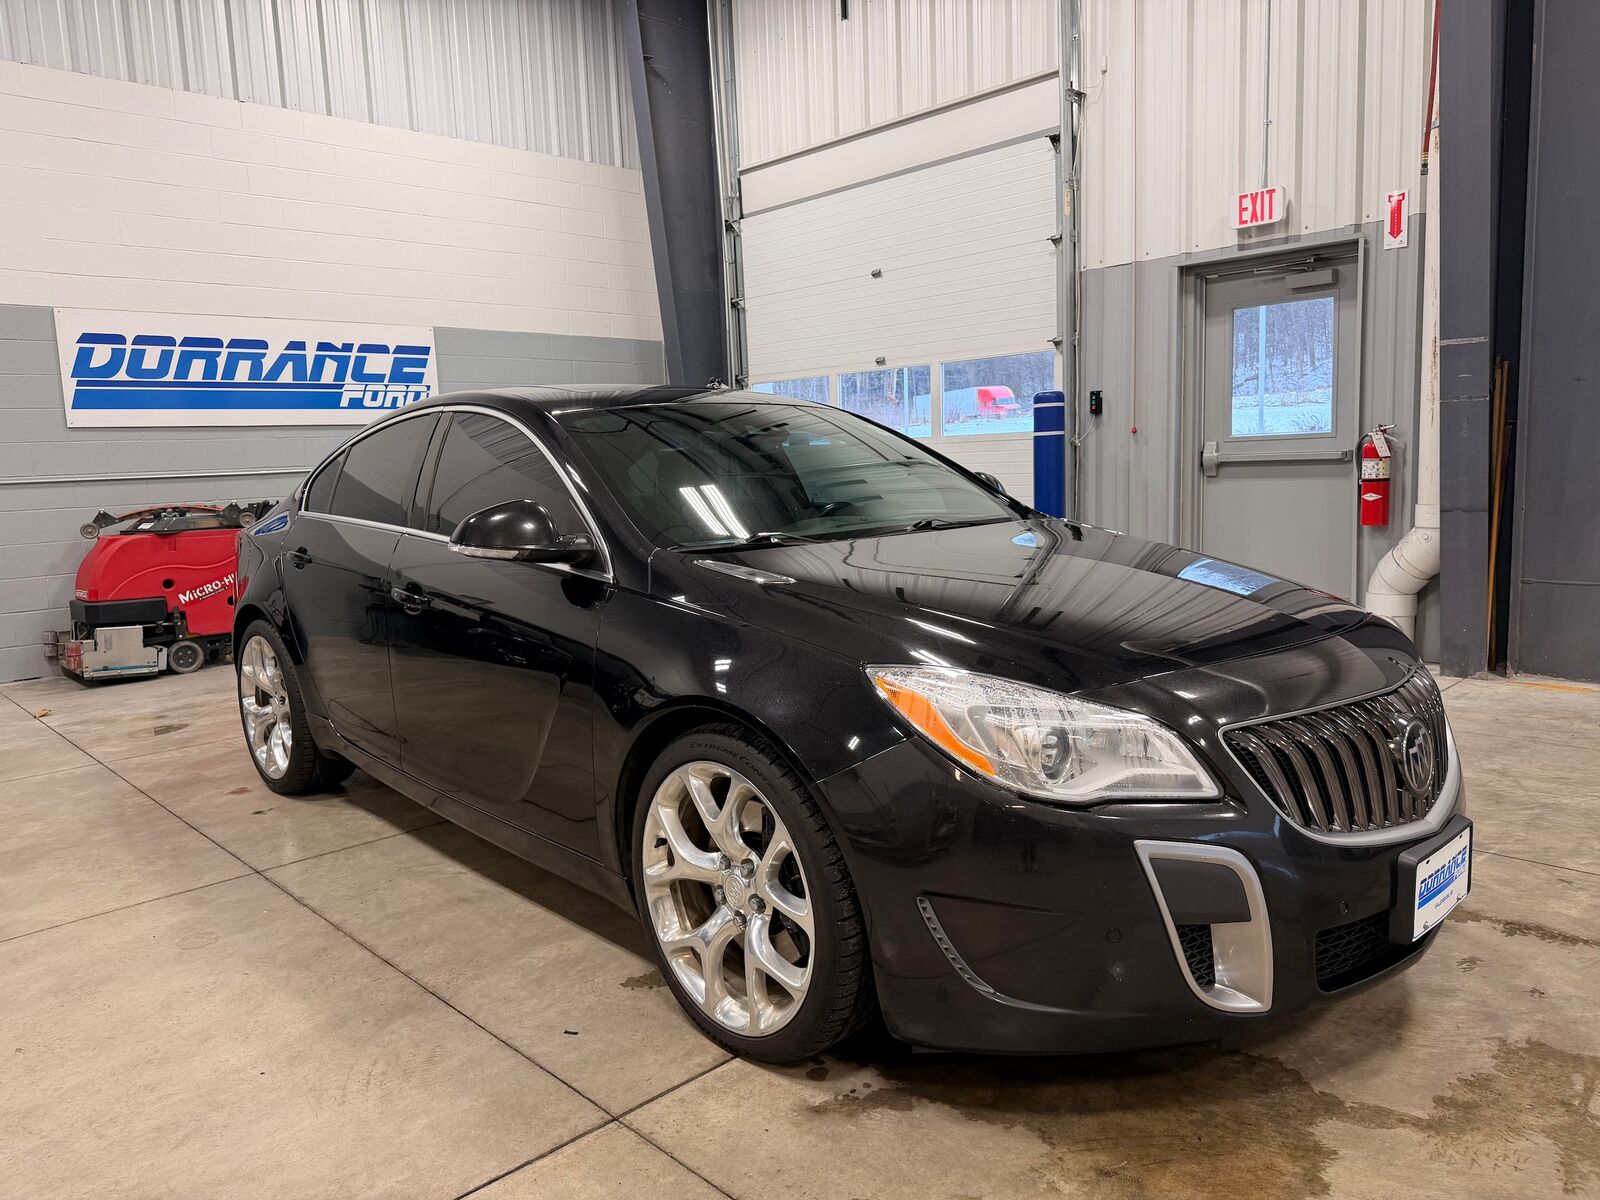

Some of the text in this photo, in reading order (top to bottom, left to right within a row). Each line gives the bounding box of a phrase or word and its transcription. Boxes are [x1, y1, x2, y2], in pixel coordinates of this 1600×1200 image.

[1238, 188, 1276, 225] EXIT
[70, 332, 431, 384] DORRANCE
[339, 384, 429, 408] FORD
